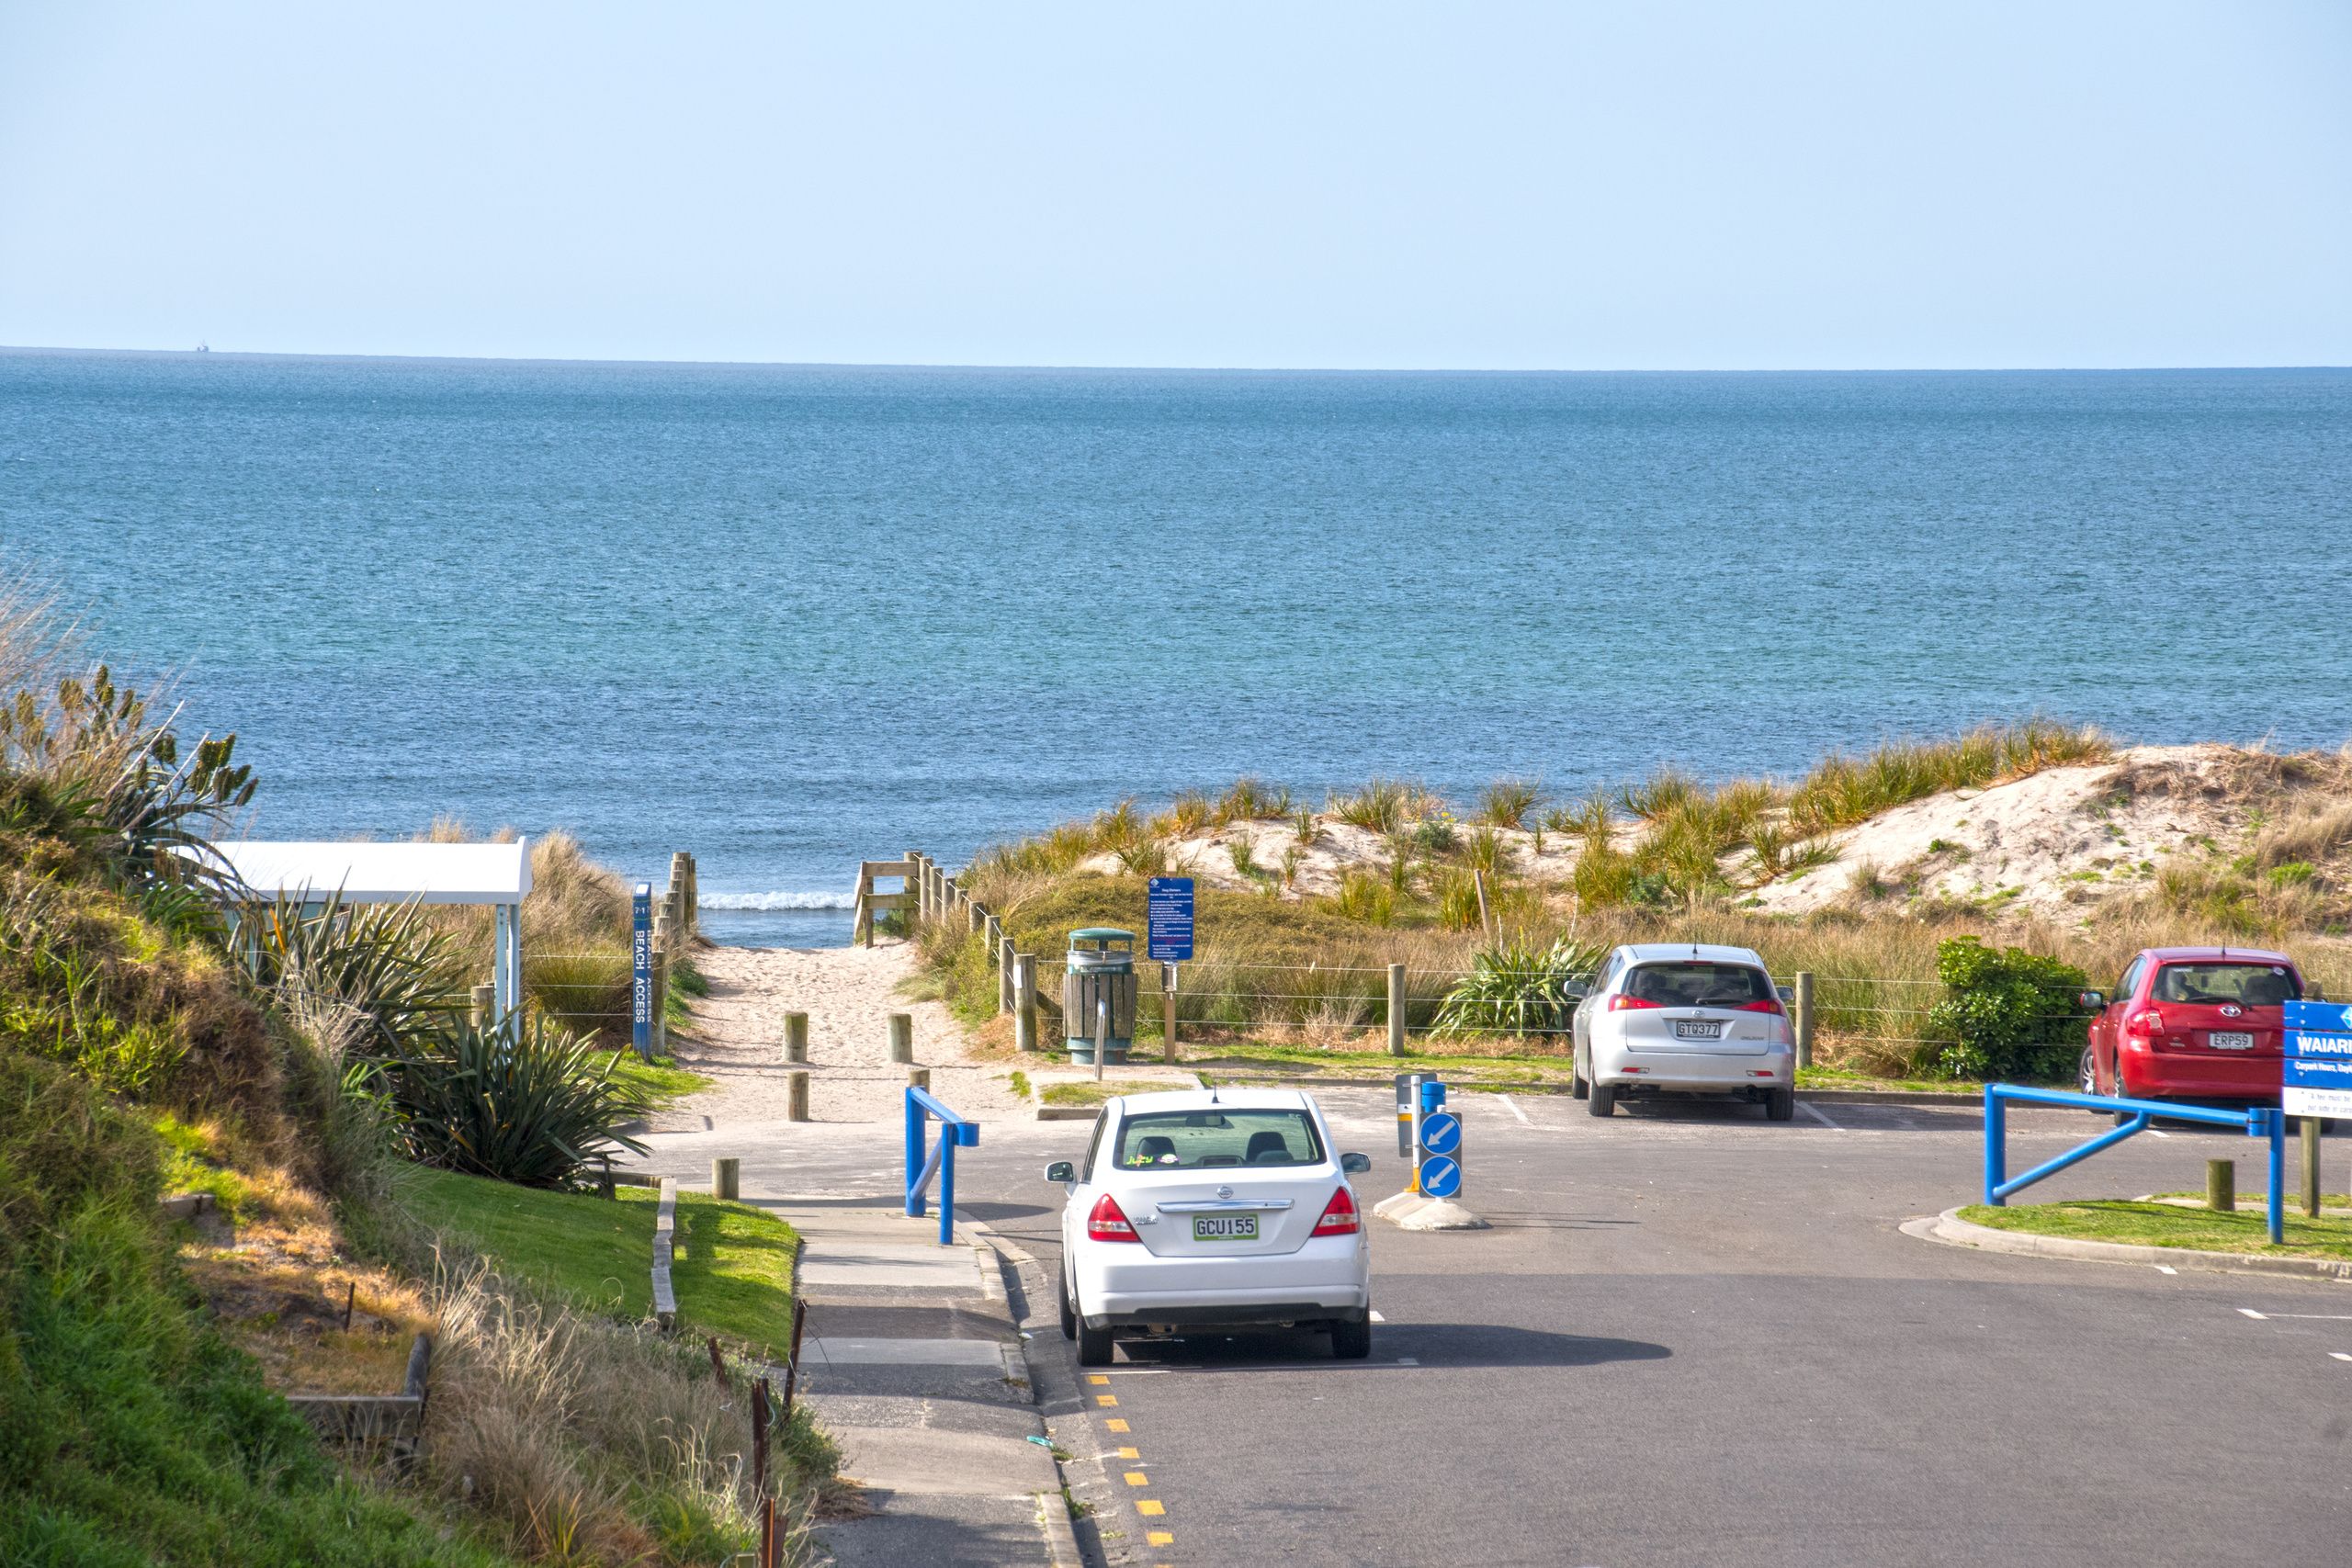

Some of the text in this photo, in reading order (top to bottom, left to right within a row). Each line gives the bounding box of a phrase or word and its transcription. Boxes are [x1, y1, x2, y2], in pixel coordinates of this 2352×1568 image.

[635, 931, 646, 1023] BEACH ACCESS
[1679, 1023, 1718, 1034] GTQ377
[2214, 1034, 2249, 1046] ERP59
[1196, 1218, 1255, 1235] GCU155
